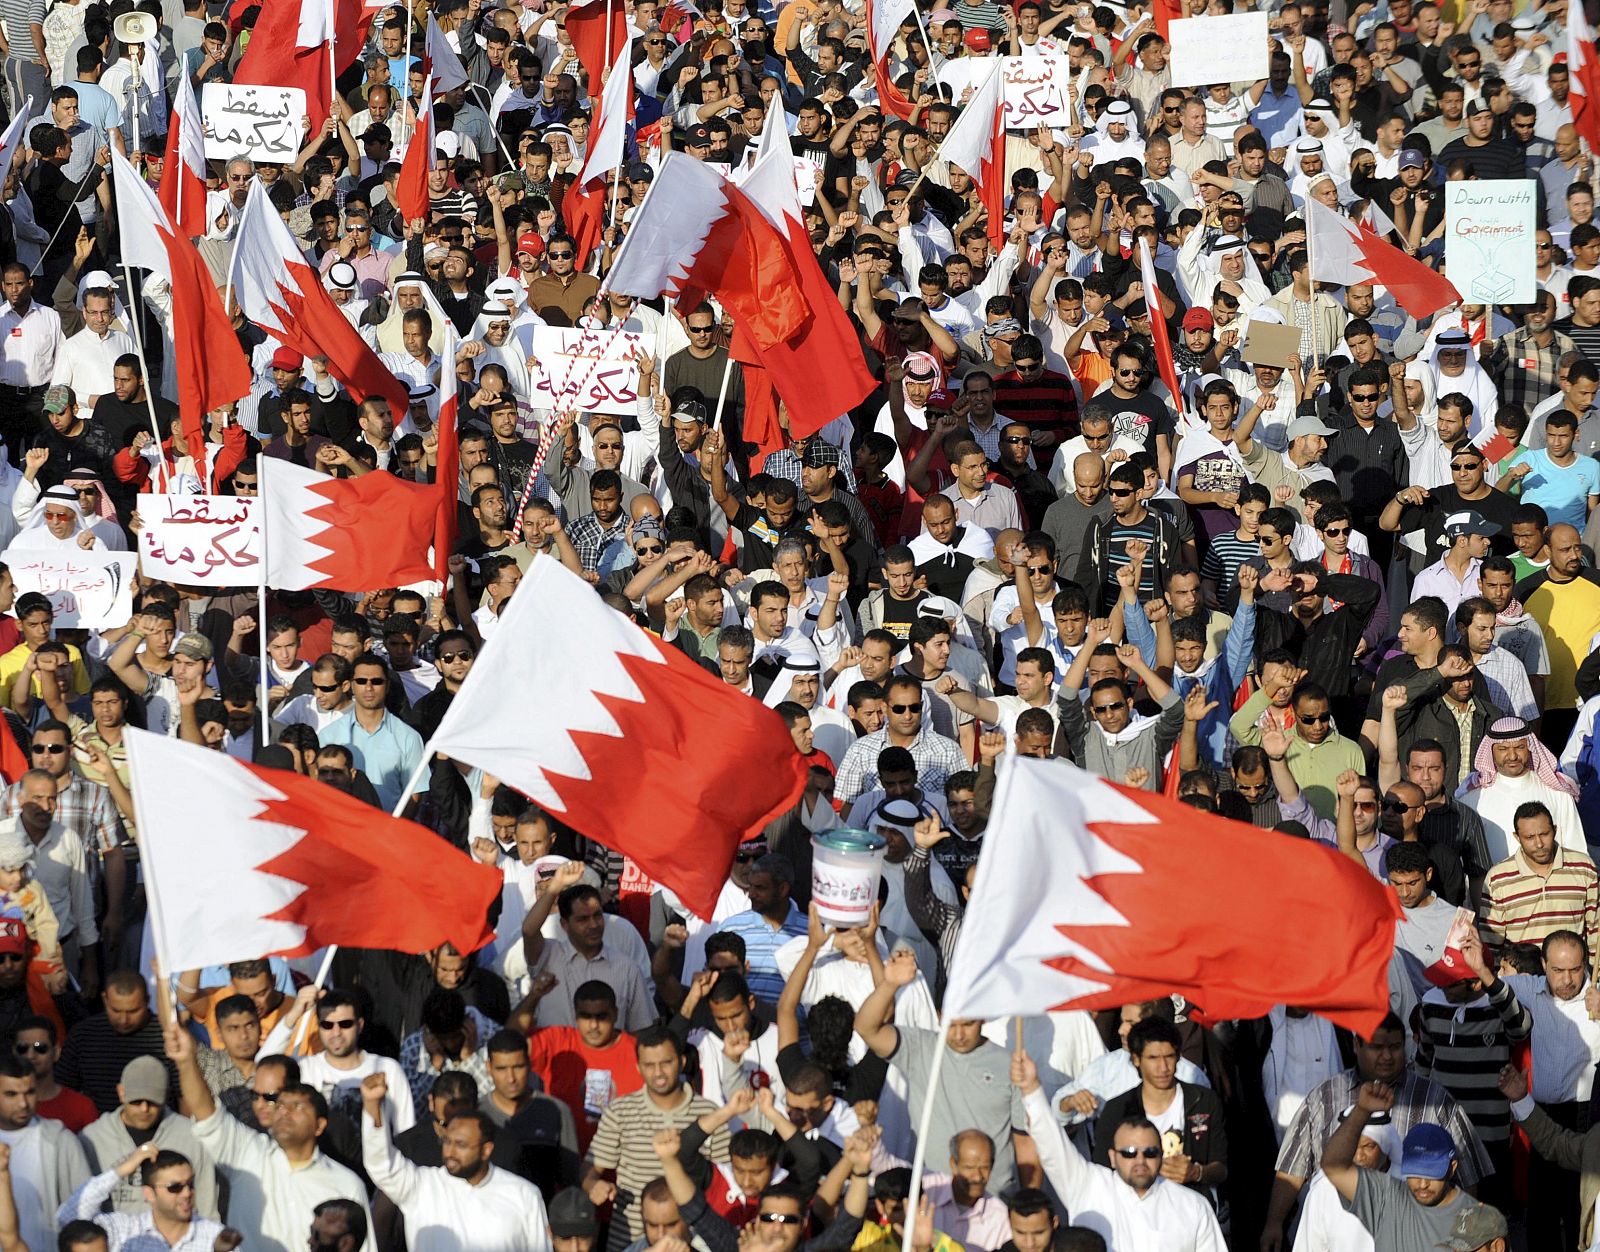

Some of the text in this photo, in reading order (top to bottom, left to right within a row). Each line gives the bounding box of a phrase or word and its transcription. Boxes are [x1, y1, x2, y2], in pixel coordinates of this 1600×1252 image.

[221, 88, 291, 119] تسقط
[1454, 188, 1531, 205] Down with
[1456, 217, 1525, 237] Government
[162, 497, 252, 525] تسقط
[620, 881, 653, 895] BAHRA
